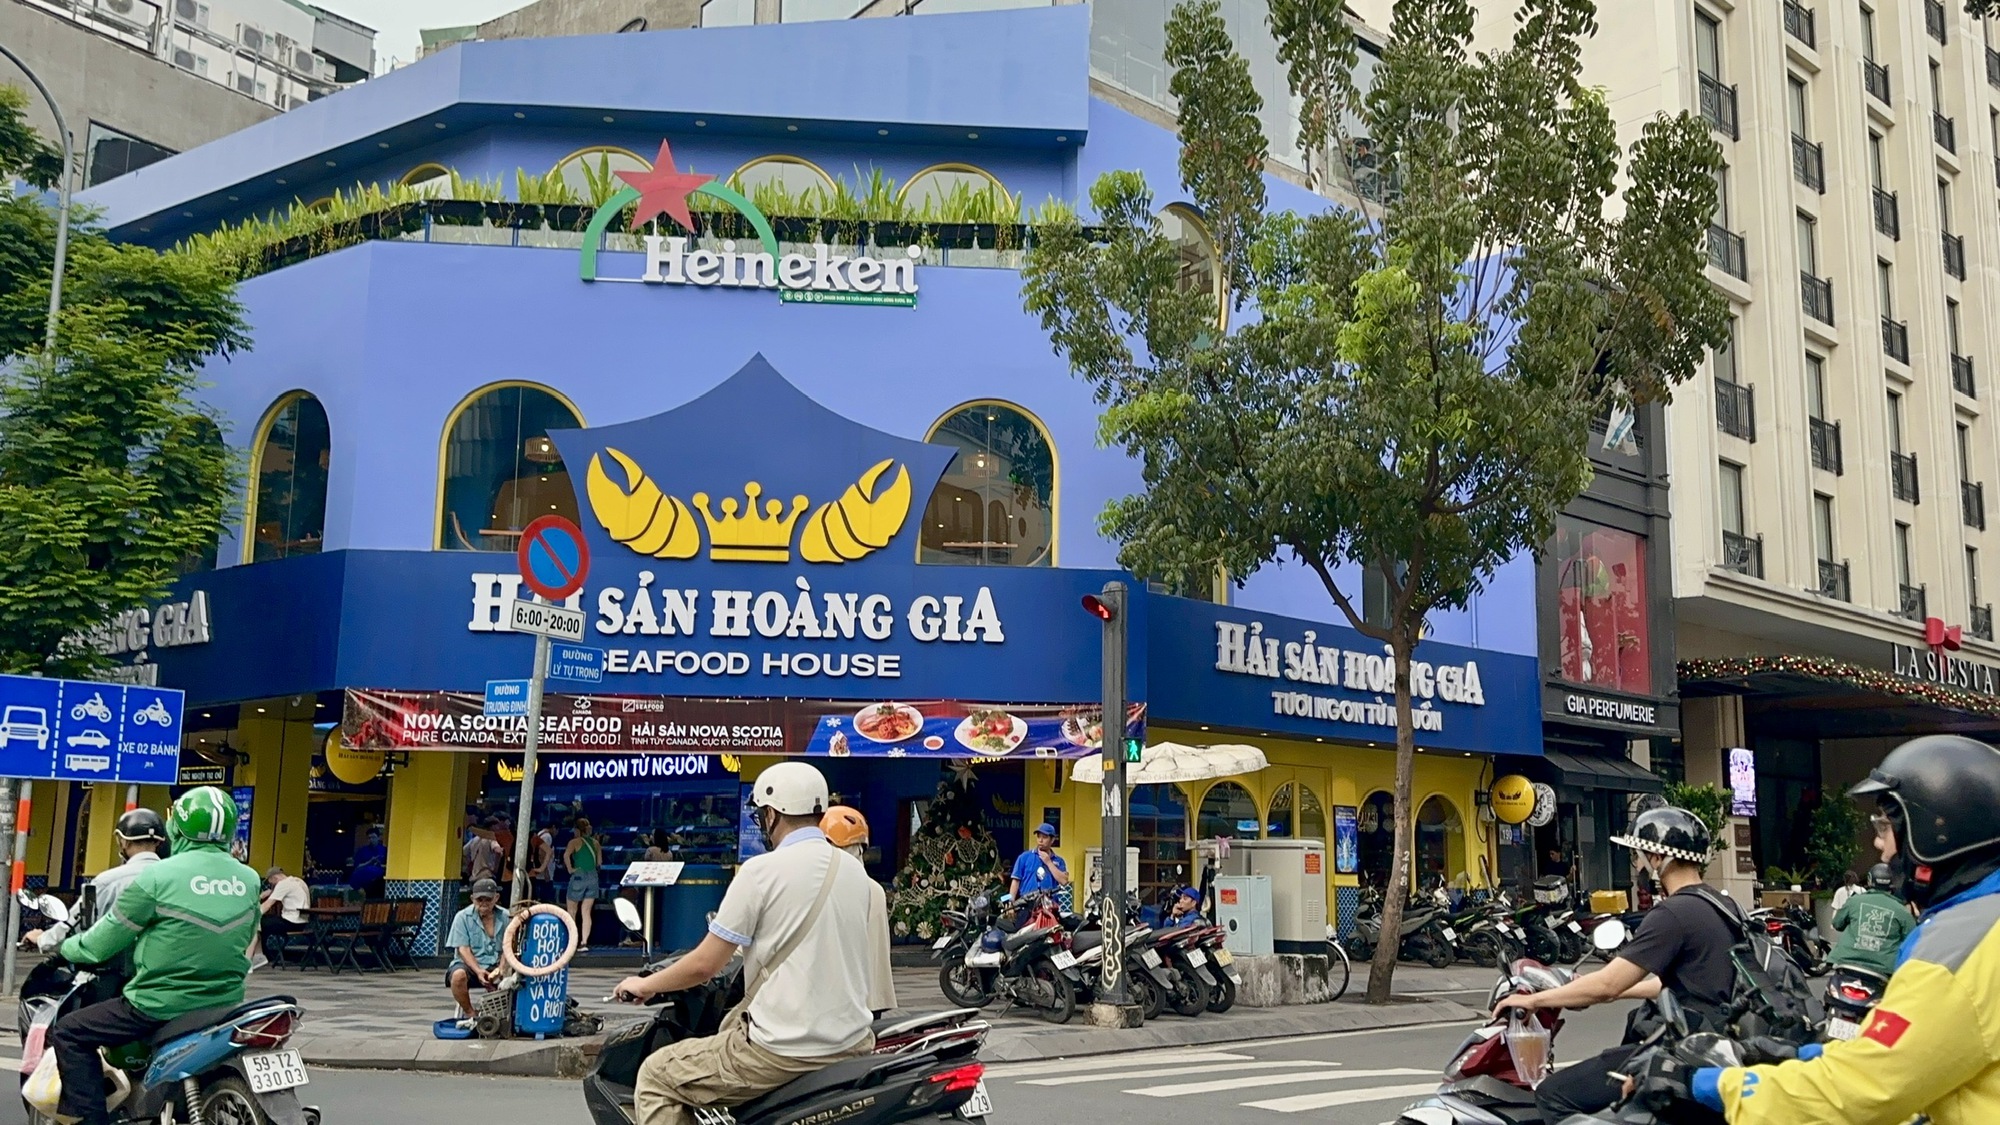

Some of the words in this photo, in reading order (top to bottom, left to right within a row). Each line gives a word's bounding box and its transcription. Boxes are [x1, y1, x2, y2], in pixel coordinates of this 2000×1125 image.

[642, 235, 919, 293] Heineken
[595, 571, 698, 638] SẢN
[711, 576, 894, 642] HOÀNG
[907, 586, 1004, 642] GIA
[153, 590, 210, 648] GIA
[553, 662, 563, 676] LÝ
[602, 648, 750, 675] EAFOOD
[762, 651, 901, 678] HOUSE
[1215, 621, 1280, 678] HẢI
[1284, 630, 1339, 686] SẢN
[1436, 661, 1485, 705] GIA
[1894, 643, 1921, 679] LA
[1927, 651, 1995, 696] SIESTA
[1272, 690, 1313, 718] TƯƠI
[1314, 698, 1365, 724] NGON
[1387, 701, 1442, 731] NUỒN
[1567, 694, 1587, 714] GIA
[1589, 698, 1655, 724] PERFUMERIE
[403, 714, 456, 730] NOVA
[460, 715, 528, 731] SCOTIA
[631, 722, 655, 737] HẢI
[658, 722, 686, 737] SẢN
[690, 725, 729, 738] NOVA
[731, 726, 783, 738] SCOTIA
[122, 742, 136, 754] XE
[137, 743, 149, 755] 02
[150, 741, 178, 756] BÁNH
[402, 730, 438, 742] PURE
[442, 731, 499, 744] CANADA,
[503, 731, 578, 744] EXTEMELY
[581, 732, 621, 745] GOOD!
[631, 737, 648, 745] TINH
[666, 738, 700, 747] CANADA,
[549, 762, 580, 780] TƯƠI
[583, 758, 628, 780] NGON
[190, 875, 247, 897] Grab
[252, 1053, 294, 1072] 59-T2
[253, 1068, 304, 1090] 330.03
